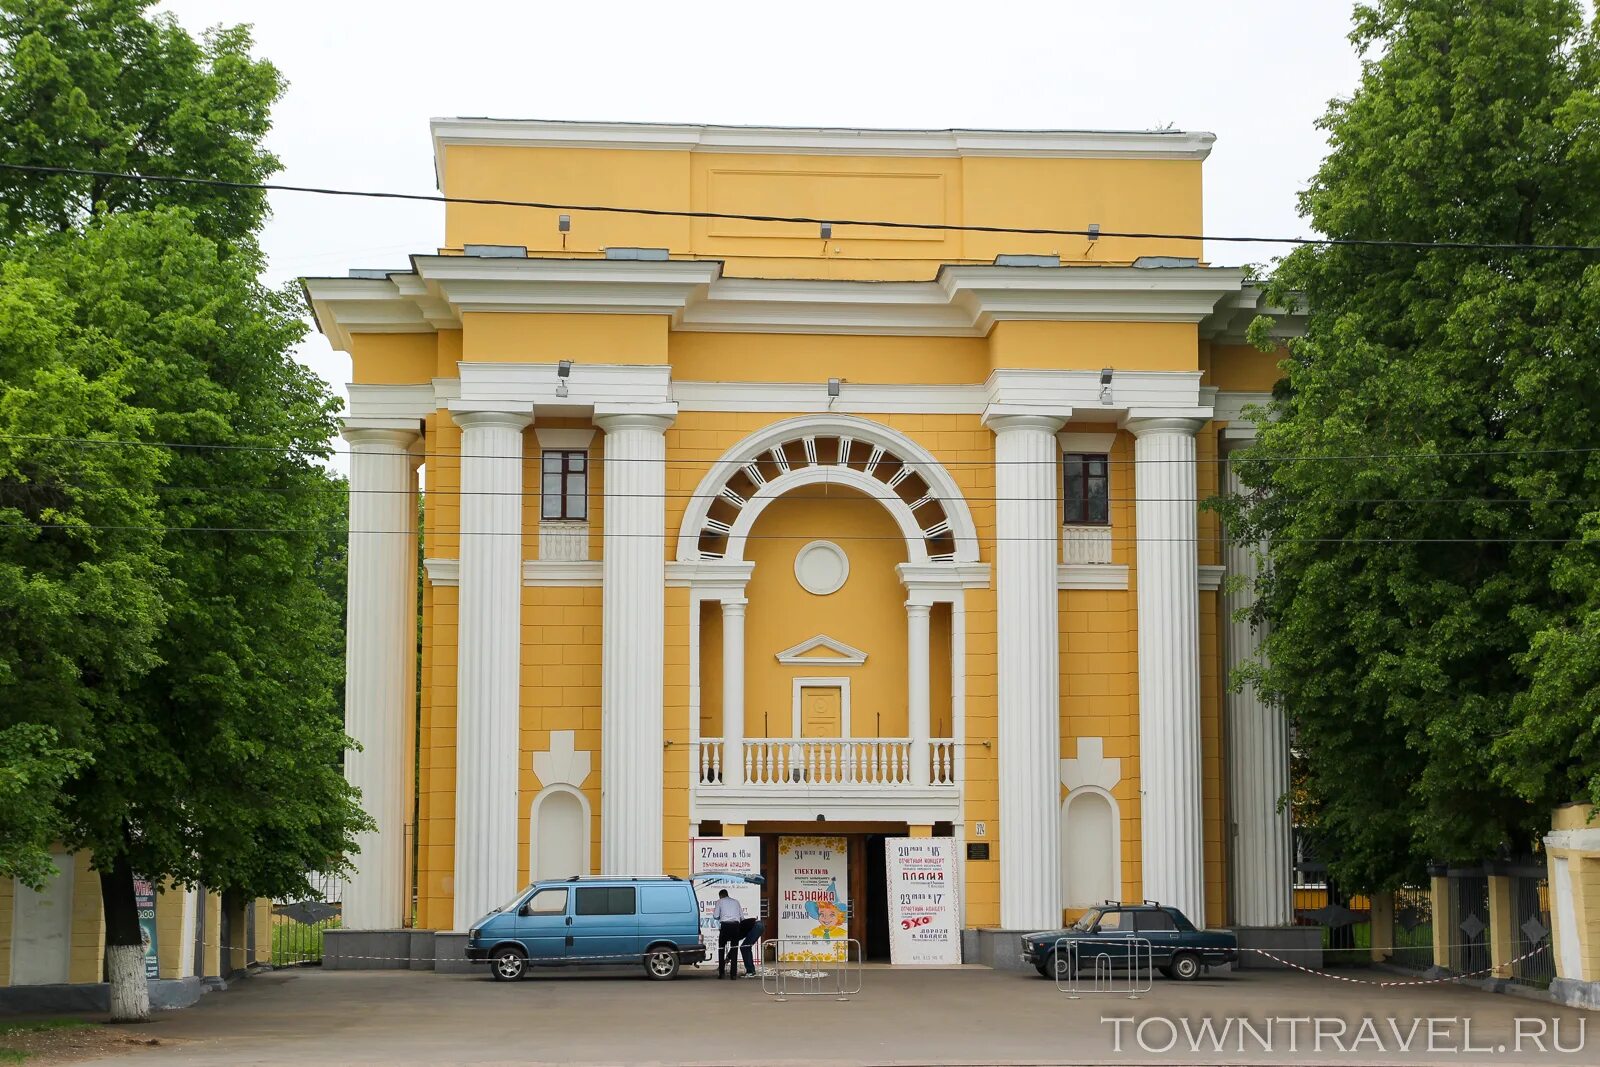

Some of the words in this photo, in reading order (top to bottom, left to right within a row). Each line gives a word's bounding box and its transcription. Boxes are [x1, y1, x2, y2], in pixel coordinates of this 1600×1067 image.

[701, 847, 713, 858] 27
[794, 850, 803, 860] 31
[898, 846, 909, 857] 20
[902, 872, 944, 881] ПЛАМЯ
[784, 888, 835, 901] НЕЗНАЙКА
[900, 894, 911, 905] 23
[933, 894, 942, 905] 17
[781, 911, 810, 920] ДРУЗЬЯ
[900, 916, 930, 931] ЭХО
